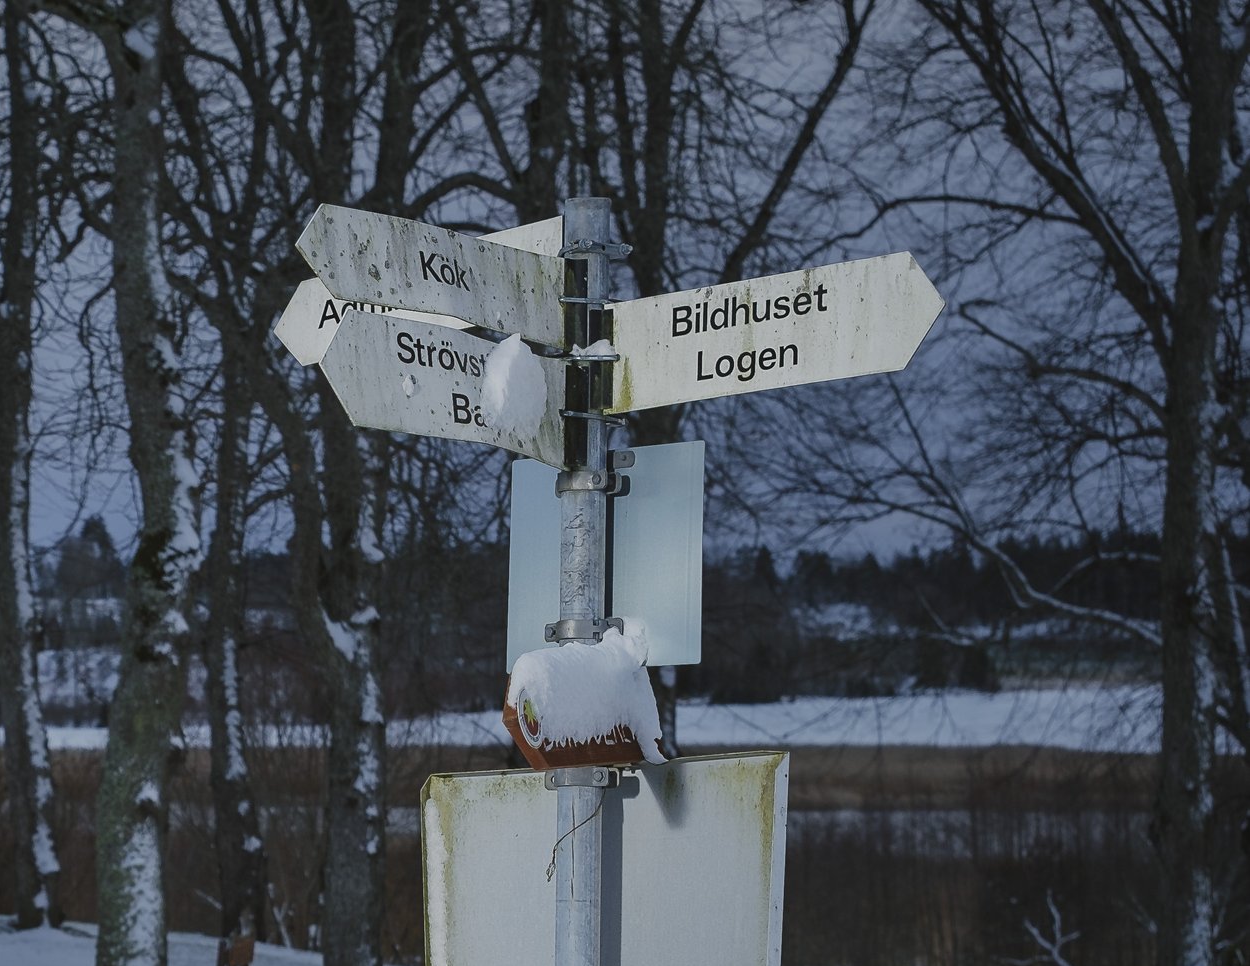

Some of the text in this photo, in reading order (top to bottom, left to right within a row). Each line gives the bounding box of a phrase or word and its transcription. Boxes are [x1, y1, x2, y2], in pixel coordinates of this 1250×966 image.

[419, 250, 471, 292] Kök
[672, 283, 829, 338] Bildhuset
[396, 331, 489, 378] Strövst
[696, 343, 799, 382] Logen
